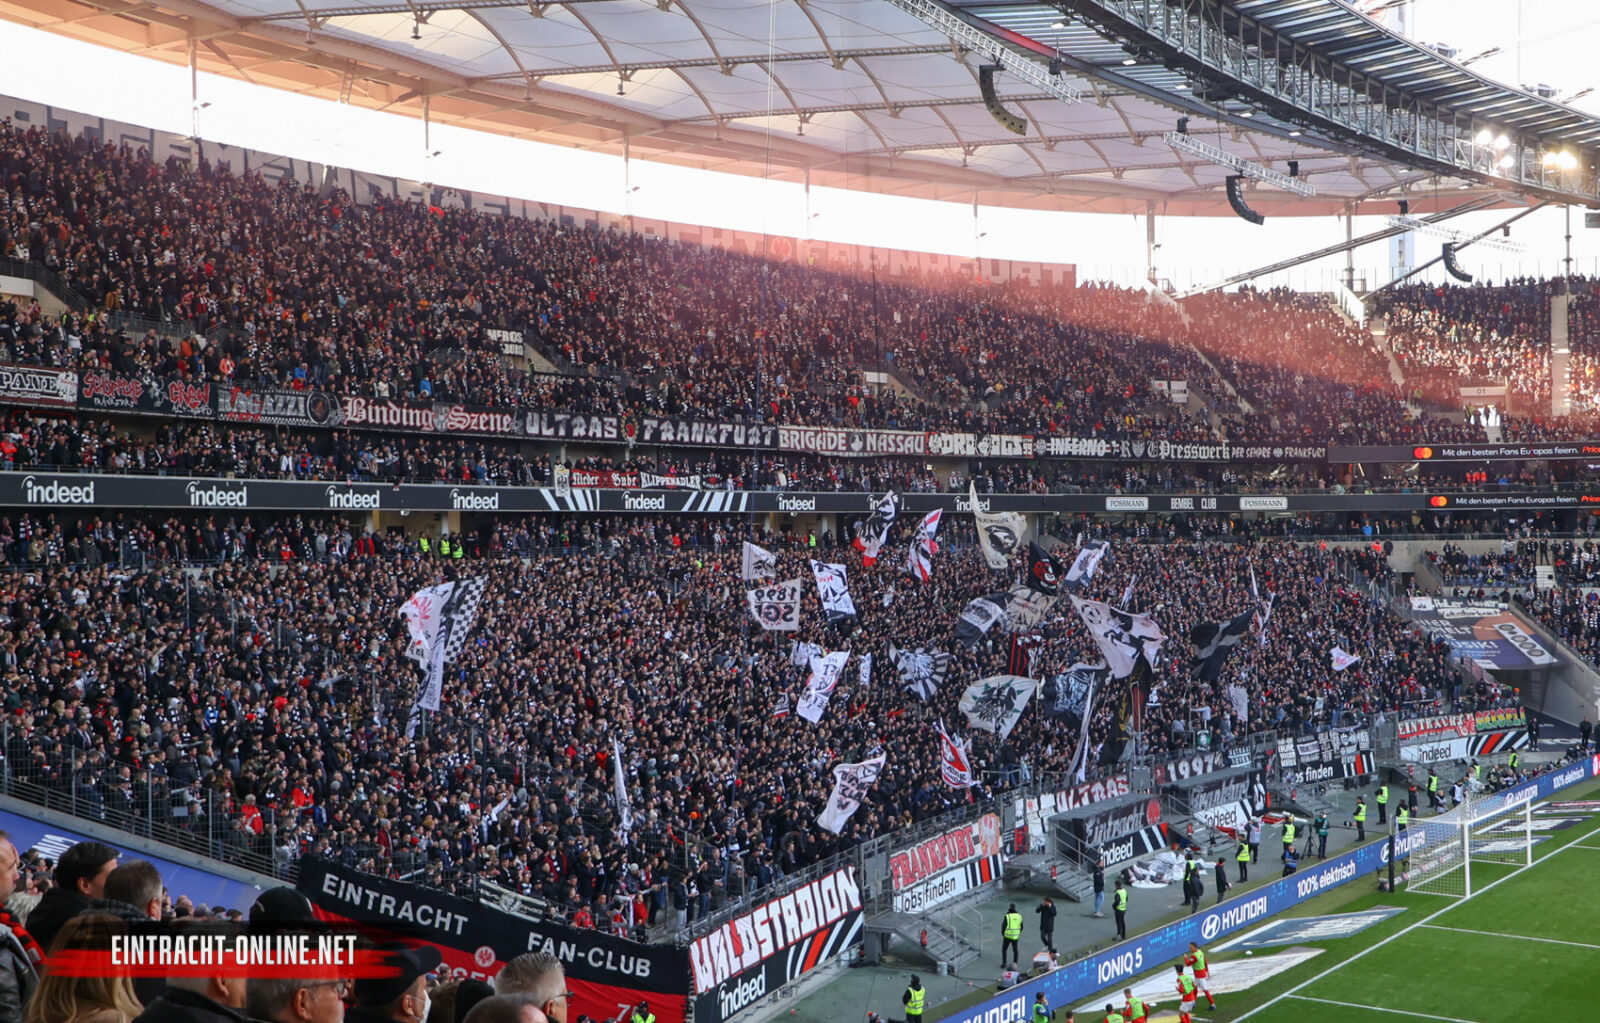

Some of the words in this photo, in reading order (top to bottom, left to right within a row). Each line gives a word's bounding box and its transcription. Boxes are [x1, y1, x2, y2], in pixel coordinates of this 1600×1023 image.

[217, 389, 306, 416] RAGAZZI
[343, 397, 436, 431] Binding
[448, 404, 511, 433] Szene
[526, 412, 617, 439] ULTRAS
[643, 417, 775, 447] FRANKFURT
[779, 428, 847, 451] BRIGADE
[866, 433, 924, 452] NASSAU
[1050, 437, 1107, 456] INFERNO
[1159, 440, 1230, 459] Presswerk
[1284, 447, 1326, 458] FRANKFURT
[1442, 448, 1456, 456] Mit
[1458, 448, 1469, 456] den
[1471, 448, 1498, 456] besten
[1500, 447, 1519, 456] Fans
[24, 477, 94, 504] indeed
[640, 471, 701, 489] KLIPPENADLER
[189, 484, 247, 507] indeed
[328, 487, 380, 508] indeed
[452, 490, 499, 510] indeed
[624, 493, 665, 510] indeed
[778, 495, 816, 510] indeed
[955, 498, 990, 511] inded
[1110, 499, 1145, 508] POSSMANN
[1171, 498, 1194, 510] BEMBEL
[1201, 498, 1216, 510] CLUB
[1244, 499, 1283, 508] POSSMANN
[1507, 496, 1524, 504] Fans
[1525, 496, 1555, 505] Europas
[1398, 713, 1464, 734] EINTRACHT
[1419, 743, 1451, 762] indeed
[1167, 752, 1216, 781] 1997
[1305, 763, 1334, 782] finden
[1553, 773, 1564, 789] 100%
[1564, 765, 1584, 785] elektrisch
[1056, 774, 1129, 813] ULTRAS
[890, 824, 975, 891] FRANKFURT
[1099, 836, 1133, 866] indeed
[925, 876, 956, 903] finden
[1297, 874, 1318, 898] 100%
[1319, 860, 1356, 888] elektrisch
[1222, 895, 1268, 931] HYUNDAI
[322, 872, 468, 936] EINTRACHT
[527, 931, 651, 978] FAN-CLUB
[689, 866, 861, 995] WALDSTADION
[1098, 951, 1134, 984] IONIQ
[1135, 947, 1143, 969] 5
[718, 964, 766, 1019] indeed
[962, 996, 1026, 1023] YUNDAI
